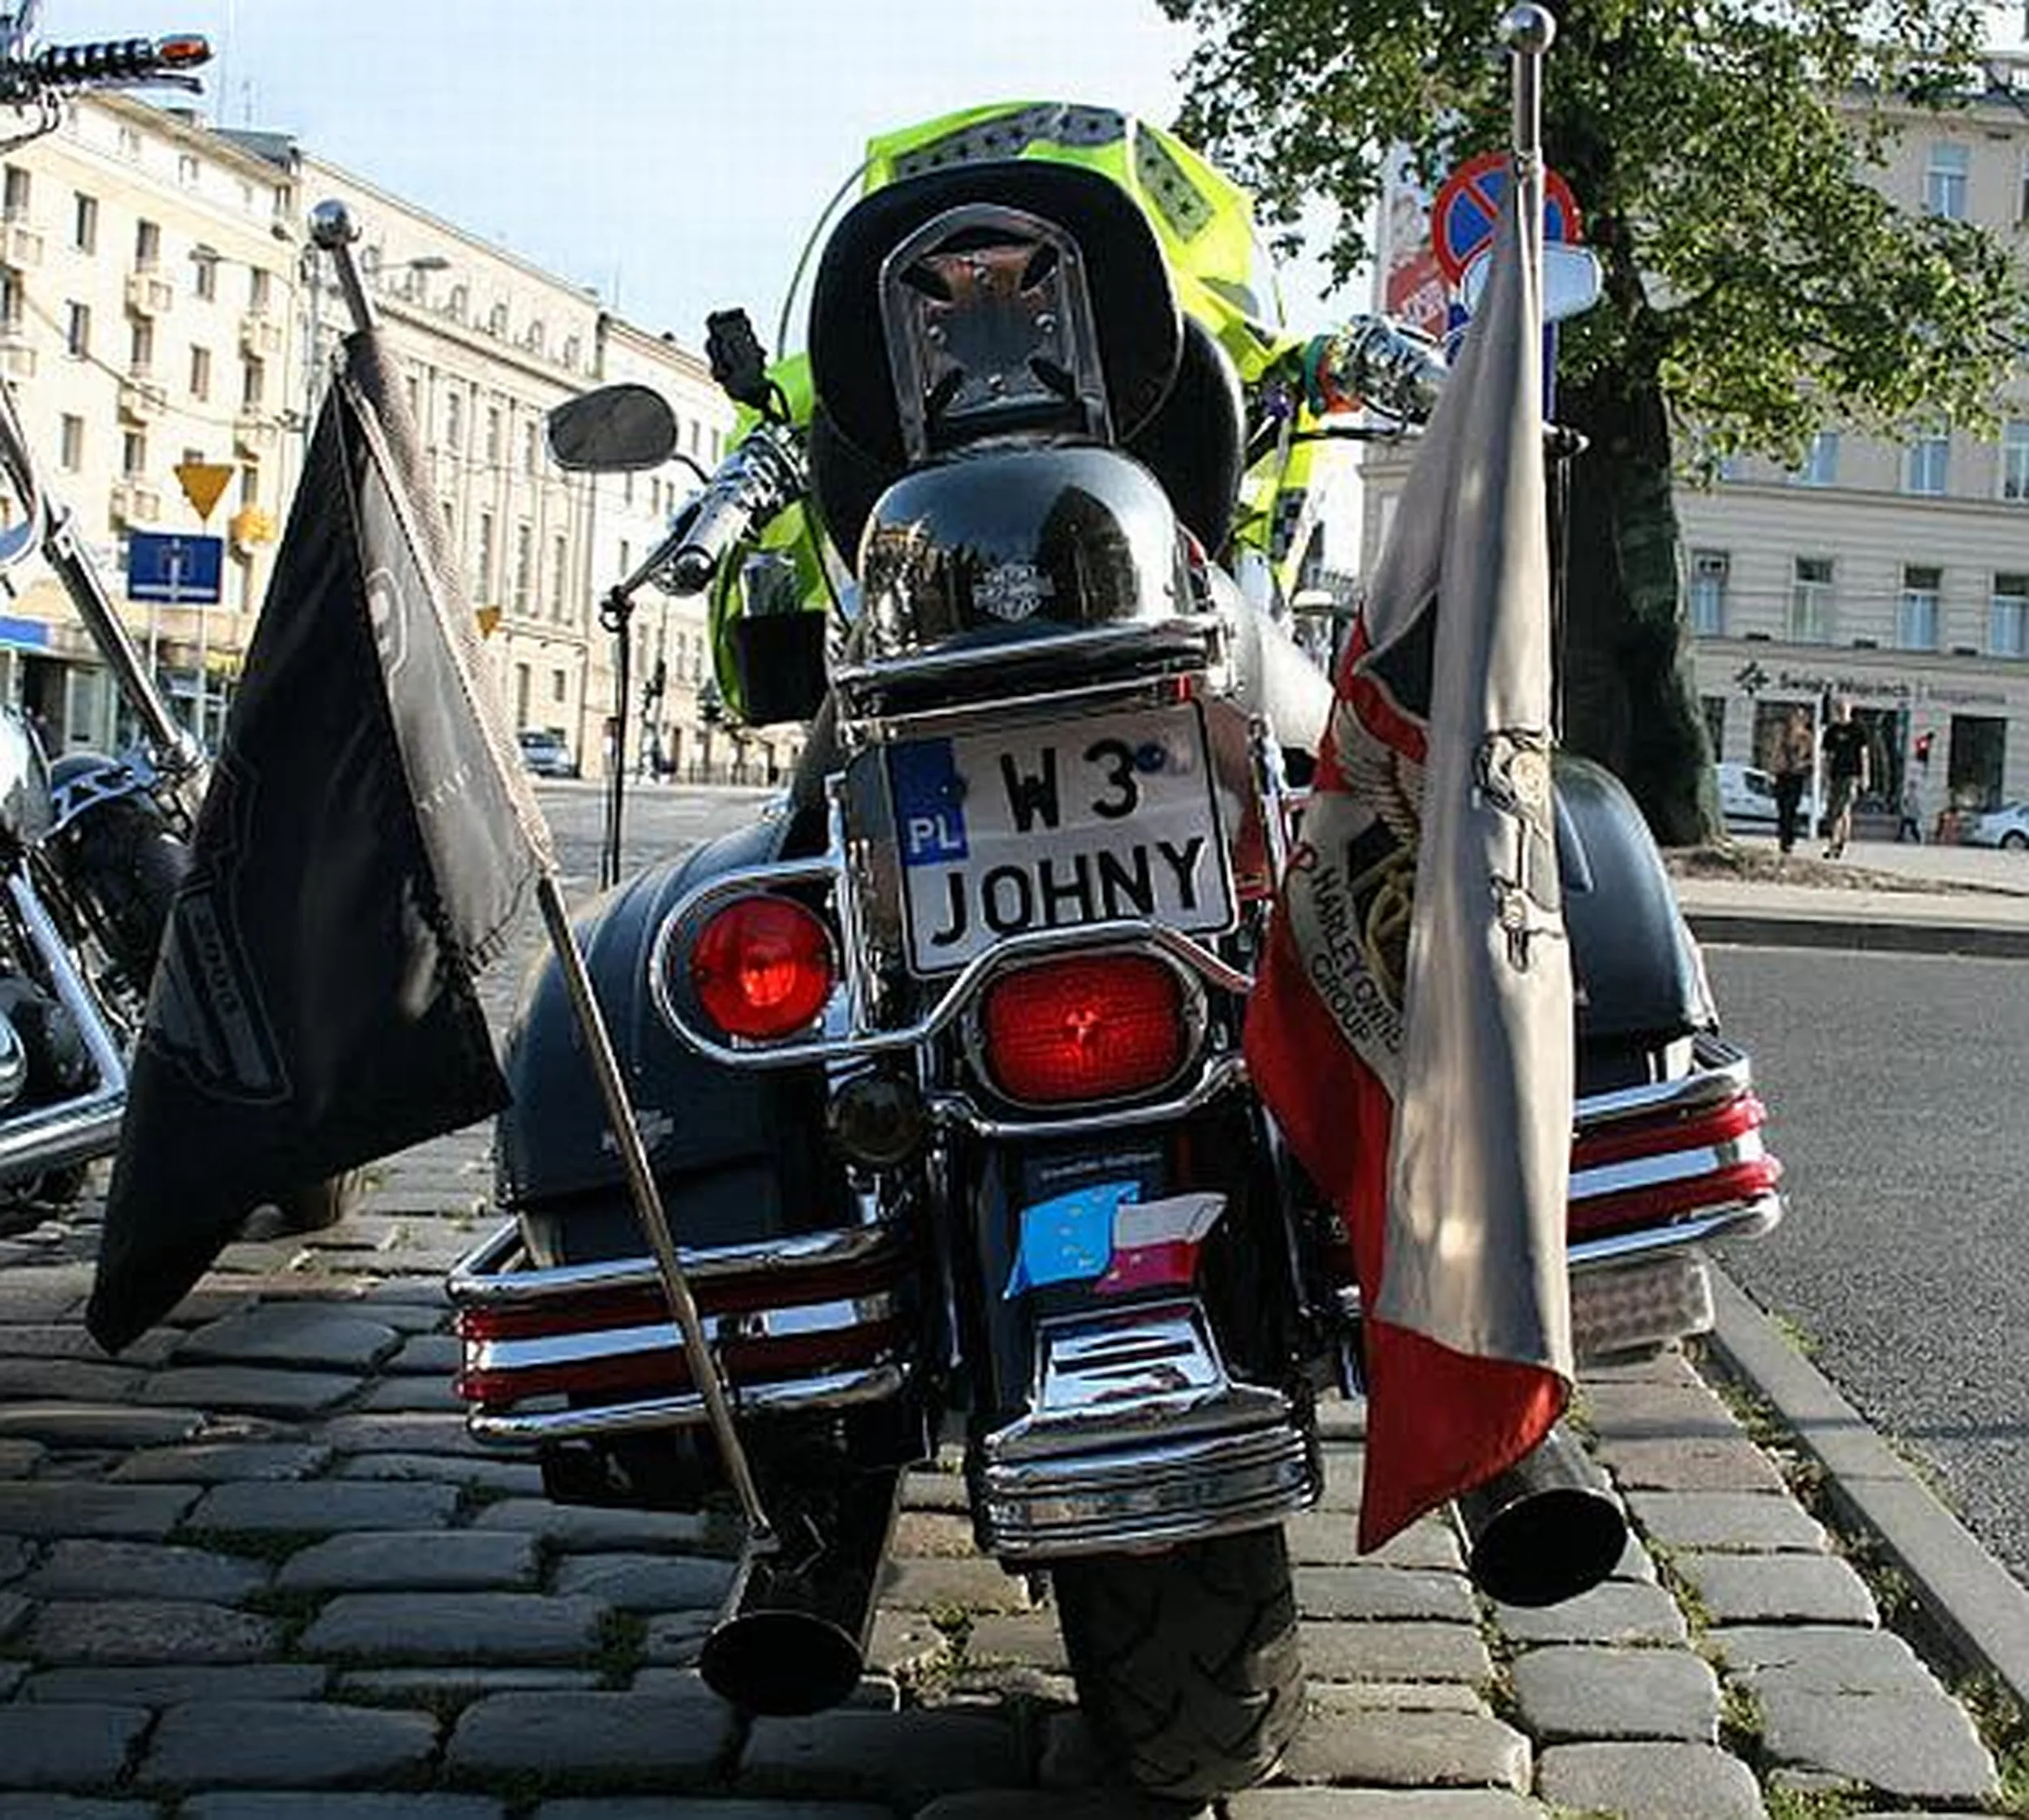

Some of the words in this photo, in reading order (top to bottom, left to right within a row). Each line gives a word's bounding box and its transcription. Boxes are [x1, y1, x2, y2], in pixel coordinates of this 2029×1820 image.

[908, 815, 962, 854] PL
[930, 835, 1205, 947] JOHNY
[1310, 864, 1368, 976] HARLEY
[1311, 952, 1372, 1043] GROUP
